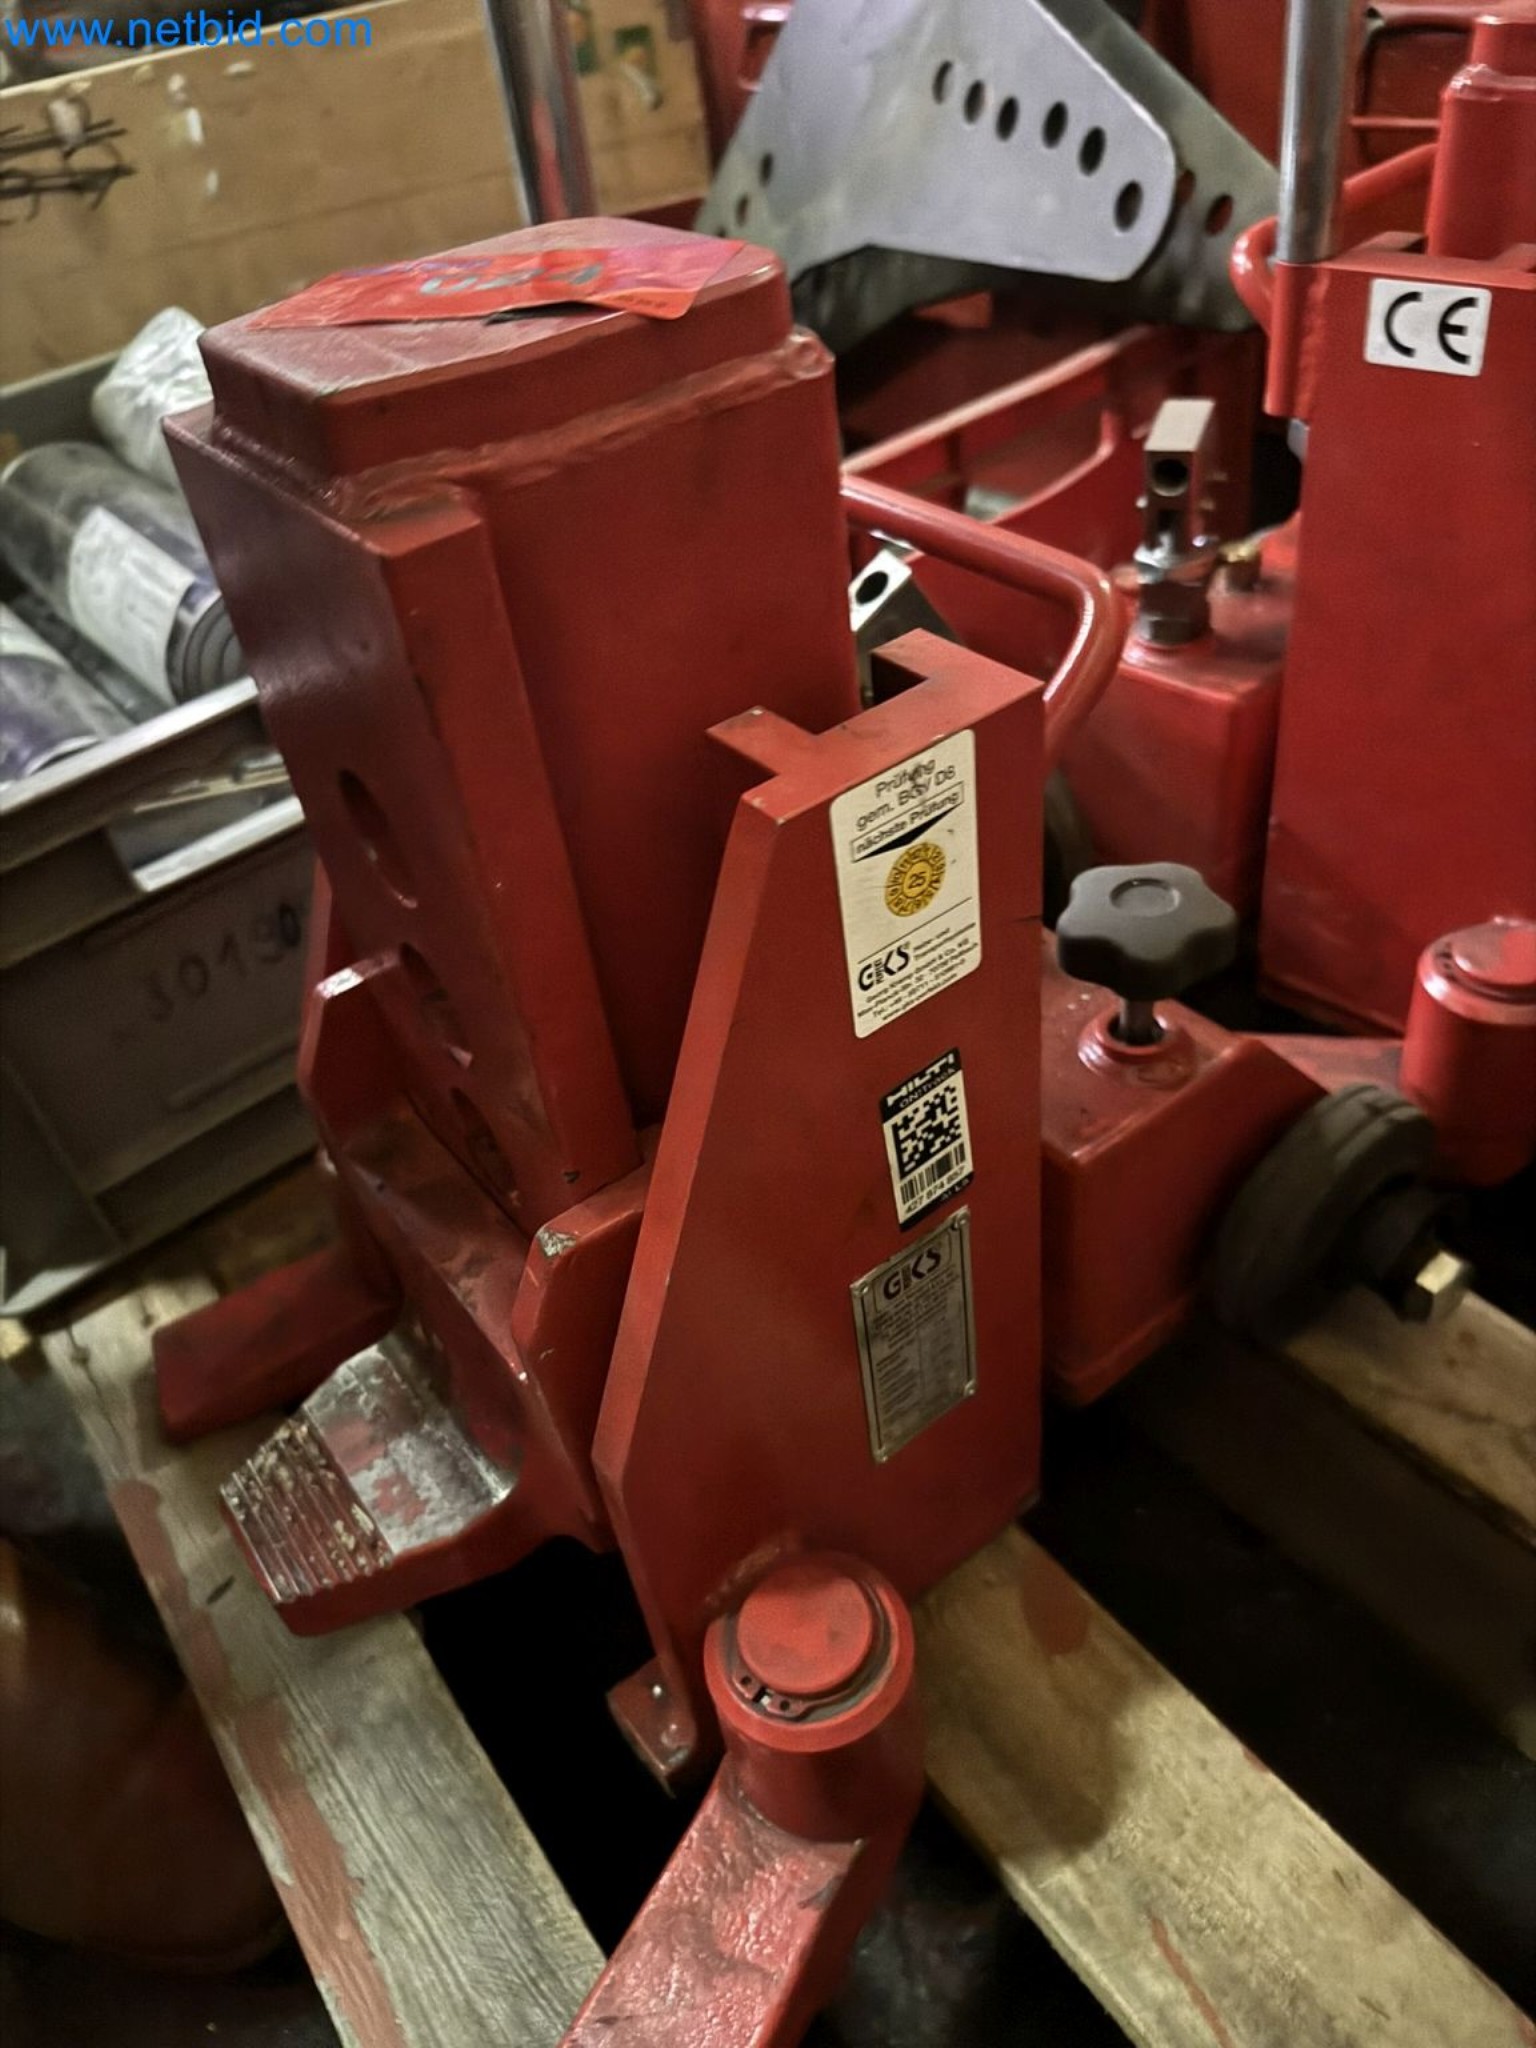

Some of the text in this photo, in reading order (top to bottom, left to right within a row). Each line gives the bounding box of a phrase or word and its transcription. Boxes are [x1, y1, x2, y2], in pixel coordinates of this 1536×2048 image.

[1384, 291, 1479, 365] CE
[875, 759, 936, 798] Prüfung
[855, 803, 894, 831] gem.
[908, 871, 926, 889] 25
[887, 1053, 954, 1106] HILTI
